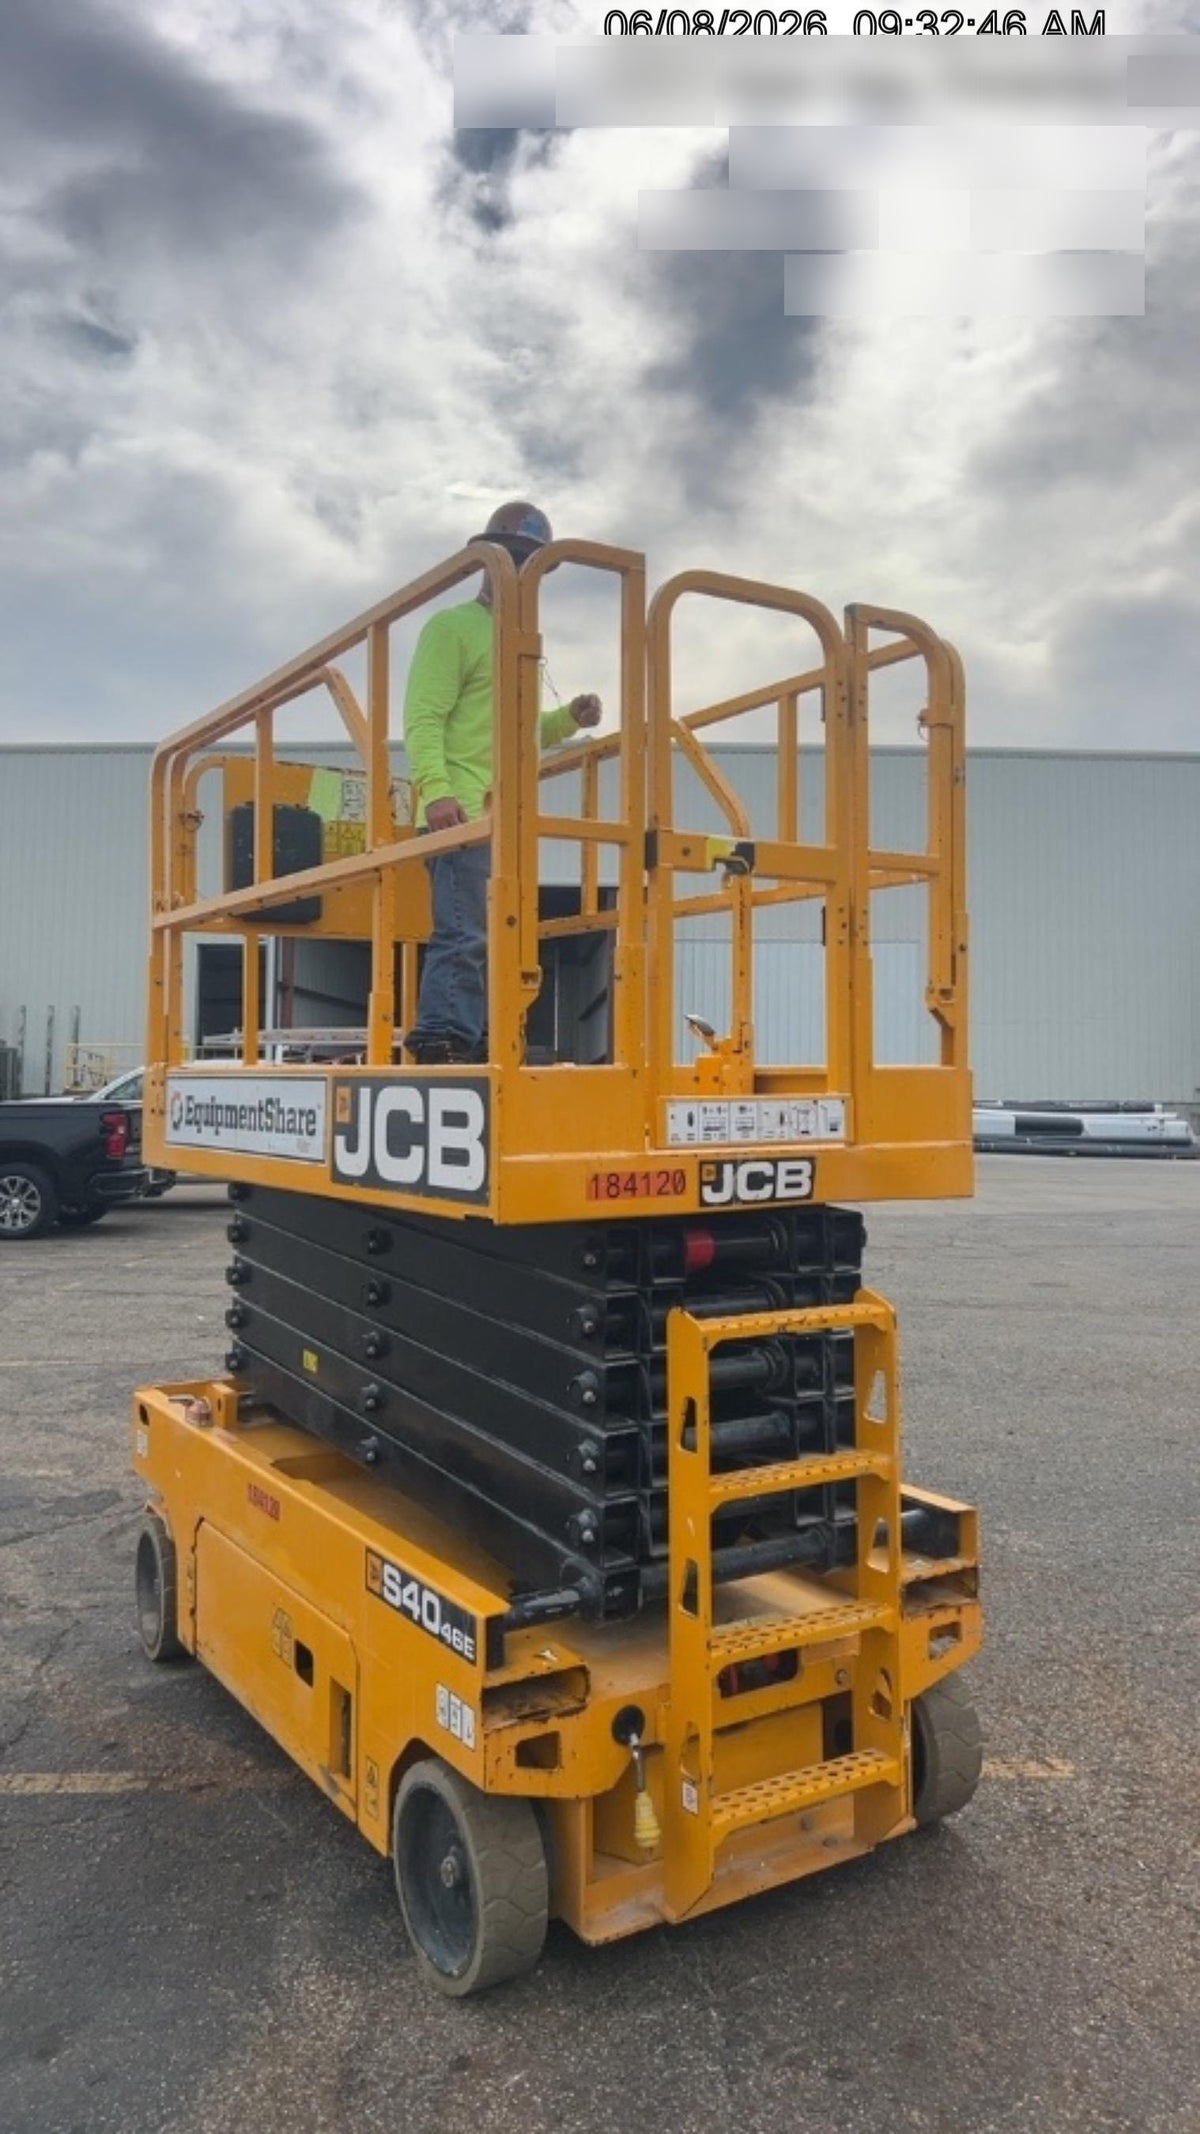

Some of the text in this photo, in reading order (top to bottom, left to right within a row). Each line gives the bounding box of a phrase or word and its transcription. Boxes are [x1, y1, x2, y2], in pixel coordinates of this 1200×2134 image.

[185, 1095, 316, 1136] EquipmentShare
[334, 1085, 485, 1191] JCB
[592, 1169, 686, 1199] 184120
[702, 1160, 812, 1204] JCB
